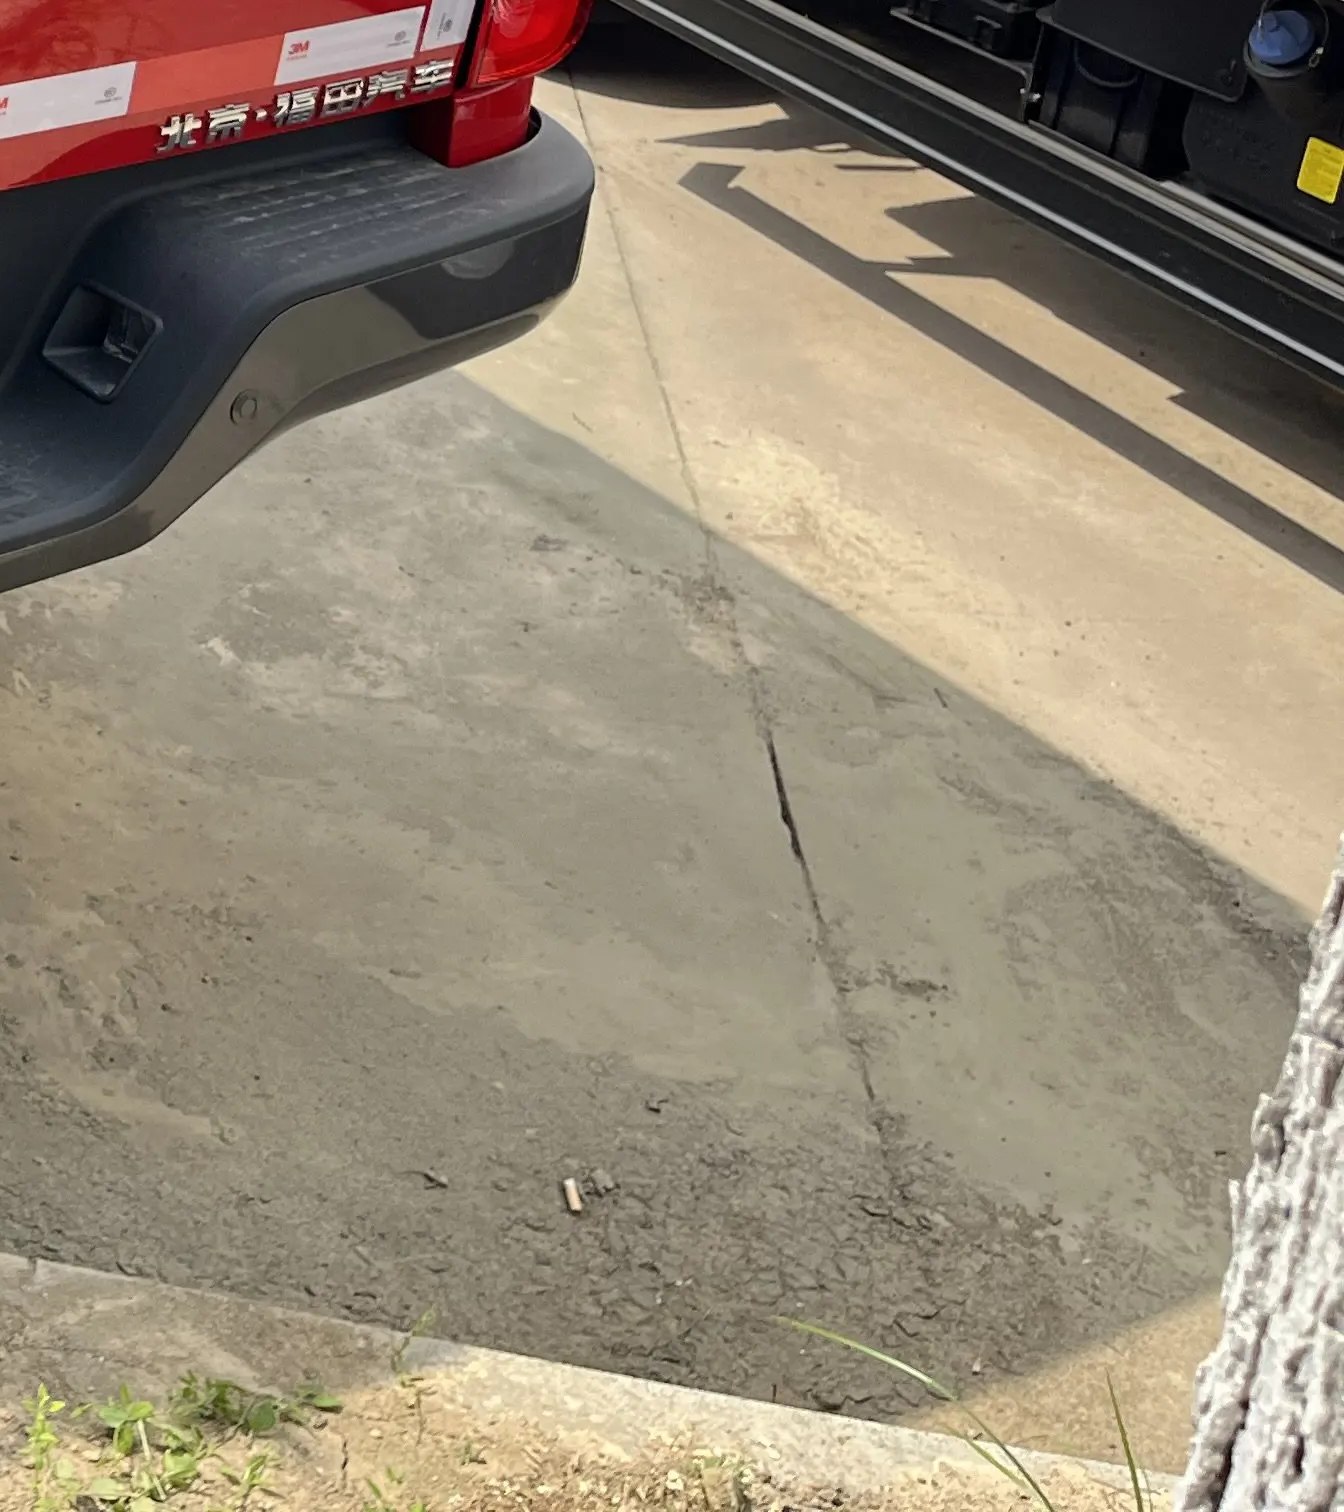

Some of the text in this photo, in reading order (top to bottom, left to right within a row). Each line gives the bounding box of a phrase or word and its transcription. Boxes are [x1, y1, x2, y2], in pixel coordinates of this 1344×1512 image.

[157, 59, 454, 153] 北京·福田汽车
